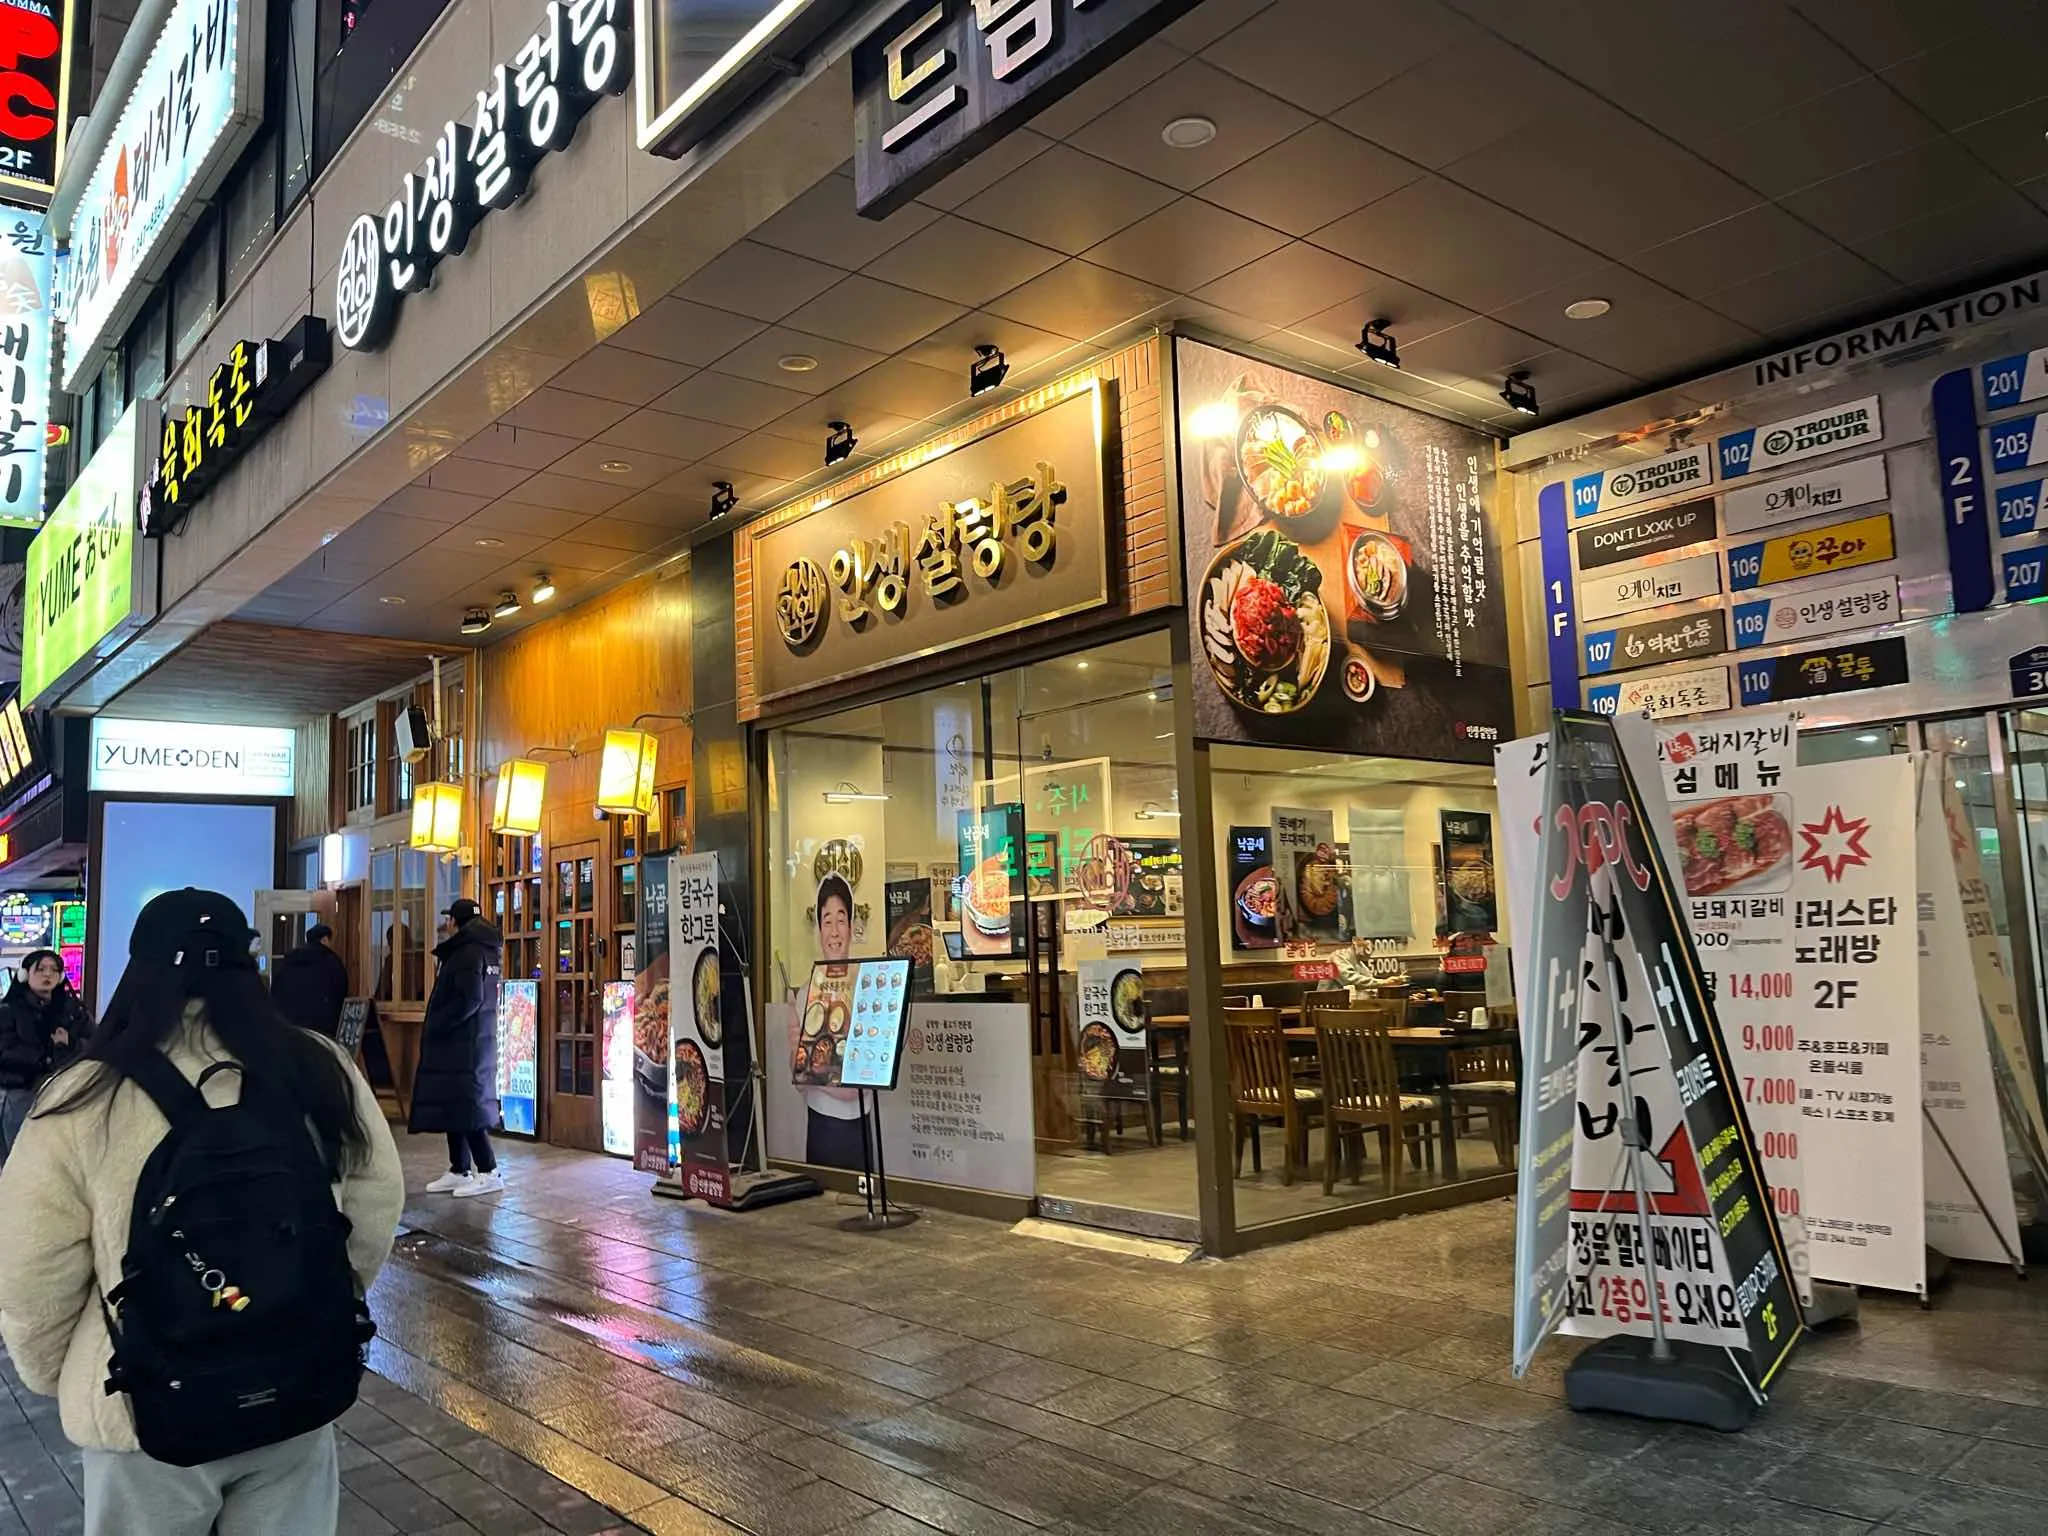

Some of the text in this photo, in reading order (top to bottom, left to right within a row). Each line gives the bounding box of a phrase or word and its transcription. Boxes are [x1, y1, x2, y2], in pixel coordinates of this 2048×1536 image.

[0, 146, 32, 170] 2F
[5, 220, 44, 256] 원
[1755, 280, 2039, 386] INFORMATION
[1987, 370, 2020, 398] 201
[161, 341, 253, 504] 육회독존
[1795, 422, 1871, 452] DOUR
[1994, 432, 2029, 459] 203
[1723, 443, 1750, 466] 102
[1467, 455, 1481, 514] 인생에
[1575, 484, 1597, 506] 101
[1637, 468, 1701, 494] DOUR
[2000, 496, 2036, 523] 205
[1593, 527, 1634, 548] DON'T
[1637, 518, 1675, 538] LXXK
[1676, 512, 1697, 527] UP
[1455, 482, 1476, 628] 인생을 추억할 맛
[1731, 556, 1759, 578] 106
[39, 532, 83, 637] YUME
[2007, 560, 2041, 588] 207
[1648, 619, 1712, 653] 역전우동
[1736, 614, 1764, 634] 108
[1588, 642, 1611, 662] 107
[1743, 671, 1770, 693] 110
[2029, 671, 2048, 692] 3
[1592, 696, 1616, 715] 109
[1698, 724, 1790, 758] 돼지갈비
[646, 883, 668, 915] 낙곱
[680, 877, 714, 909] 칼국수
[681, 913, 716, 945] 한그릇
[1729, 972, 1793, 999] 14,000
[1813, 979, 1859, 1010] 2F
[926, 1033, 975, 1054] 인생설렁탕
[1742, 1024, 1794, 1052] 9,000
[1743, 1077, 1796, 1105] 7,000
[1824, 1089, 1845, 1101] TV
[1675, 1281, 1742, 1330] 오세요
